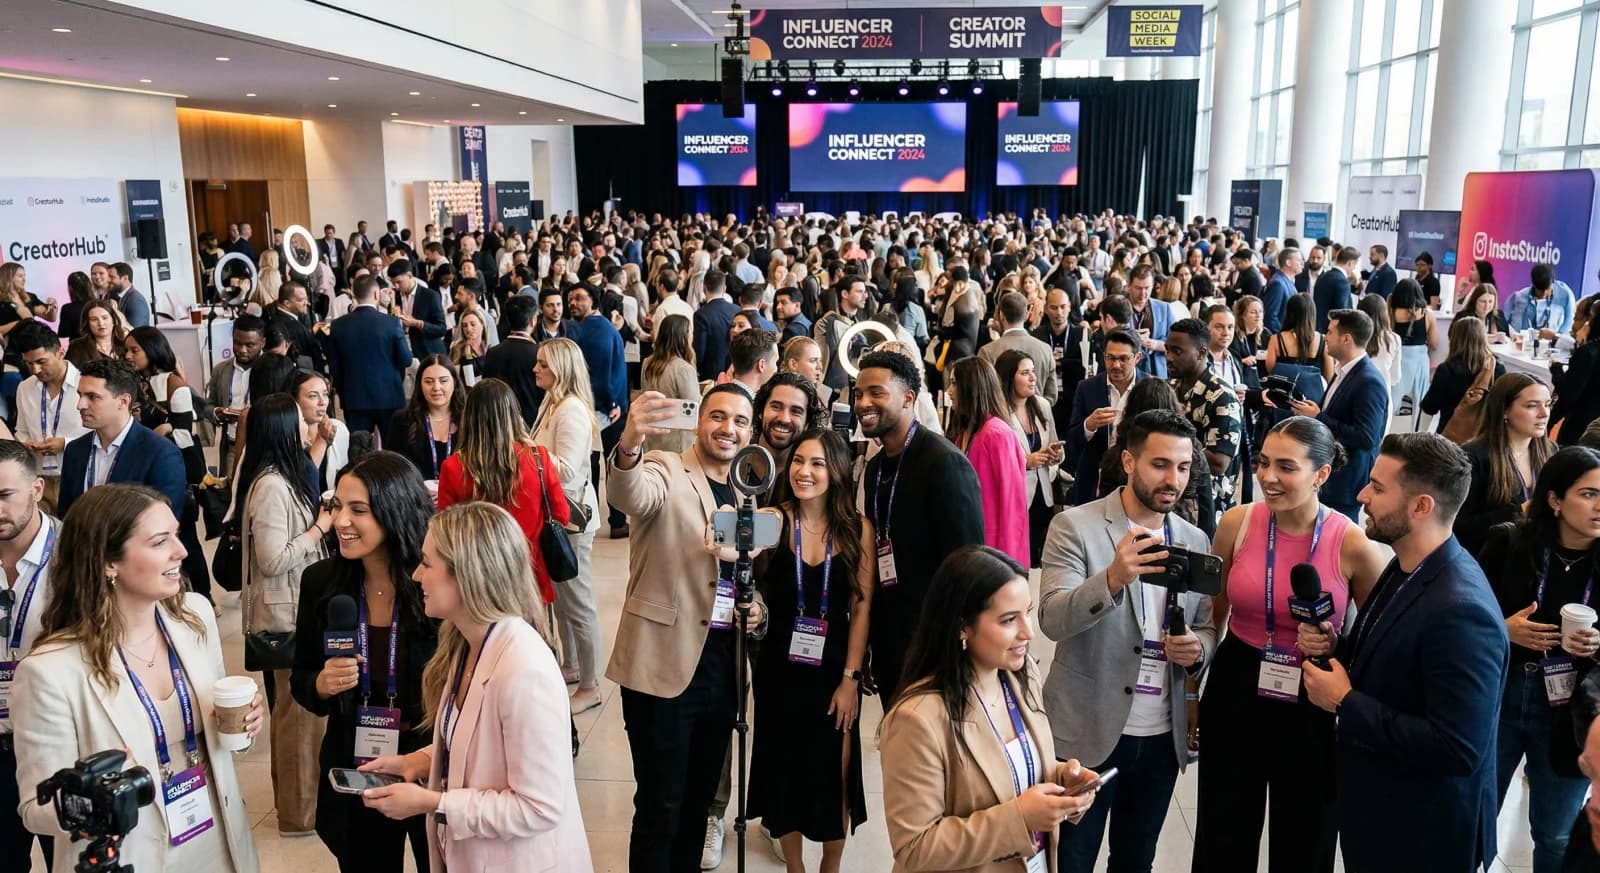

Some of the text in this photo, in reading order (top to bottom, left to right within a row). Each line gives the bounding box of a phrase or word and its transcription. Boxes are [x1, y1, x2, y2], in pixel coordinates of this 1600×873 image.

[1135, 11, 1177, 20] SOCIAL
[782, 18, 893, 34] INFLUENCER
[949, 16, 1026, 31] CREATOR
[1135, 24, 1171, 33] MEDIA
[782, 35, 893, 49] CONNECT 2024
[949, 32, 1026, 49] SUMMIT
[1134, 36, 1168, 46] WEEK
[684, 135, 749, 145] INFLUENCER
[828, 134, 926, 148] INFLUENCER
[1004, 134, 1071, 144] INFLUENCER
[684, 145, 748, 154] CONNECT 2024
[828, 148, 926, 161] CONNECT 2024
[1004, 144, 1071, 153] CONNECT 2024
[1351, 213, 1400, 232] CreatorHub
[9, 235, 107, 262] CreatorHub
[1488, 237, 1561, 266] InstaStudio
